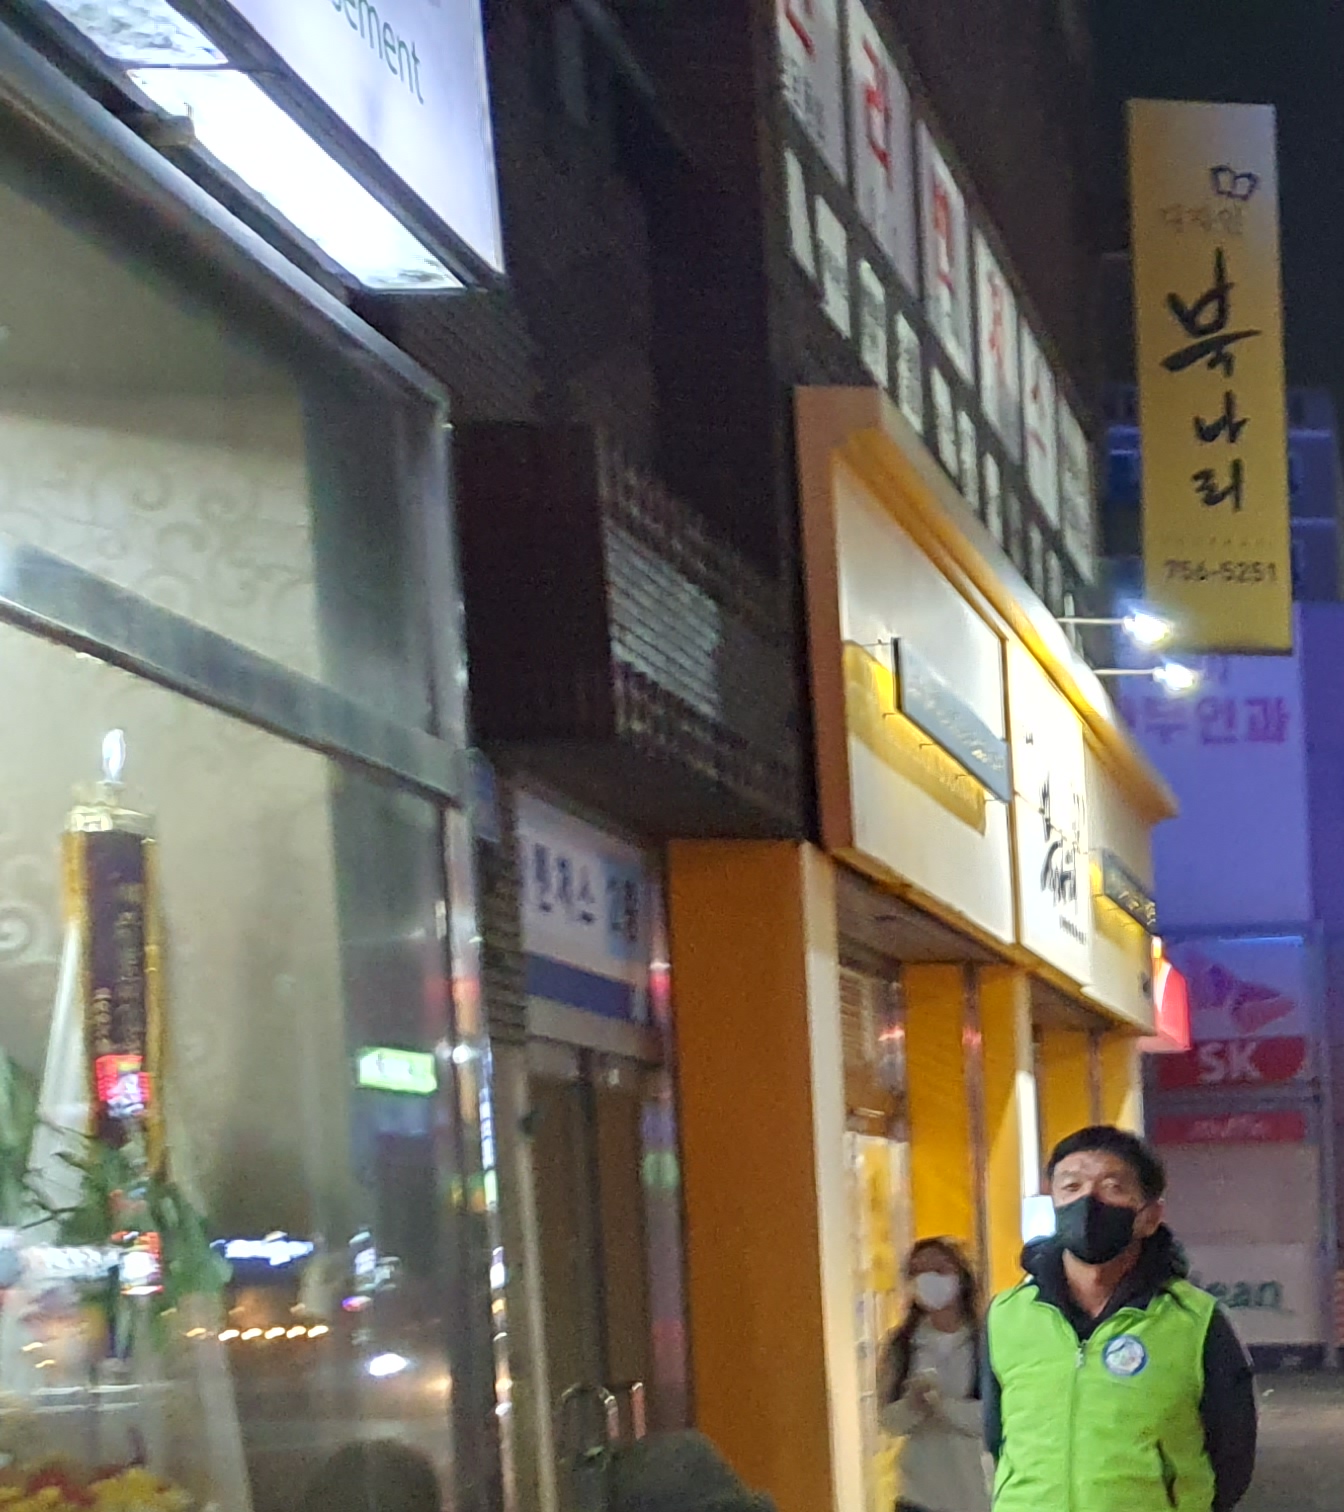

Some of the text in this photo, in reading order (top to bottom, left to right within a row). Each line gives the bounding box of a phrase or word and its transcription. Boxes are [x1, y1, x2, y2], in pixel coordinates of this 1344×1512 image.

[331, 0, 424, 105] ement
[1122, 694, 1292, 746] 부인과
[1199, 1041, 1262, 1085] SK
